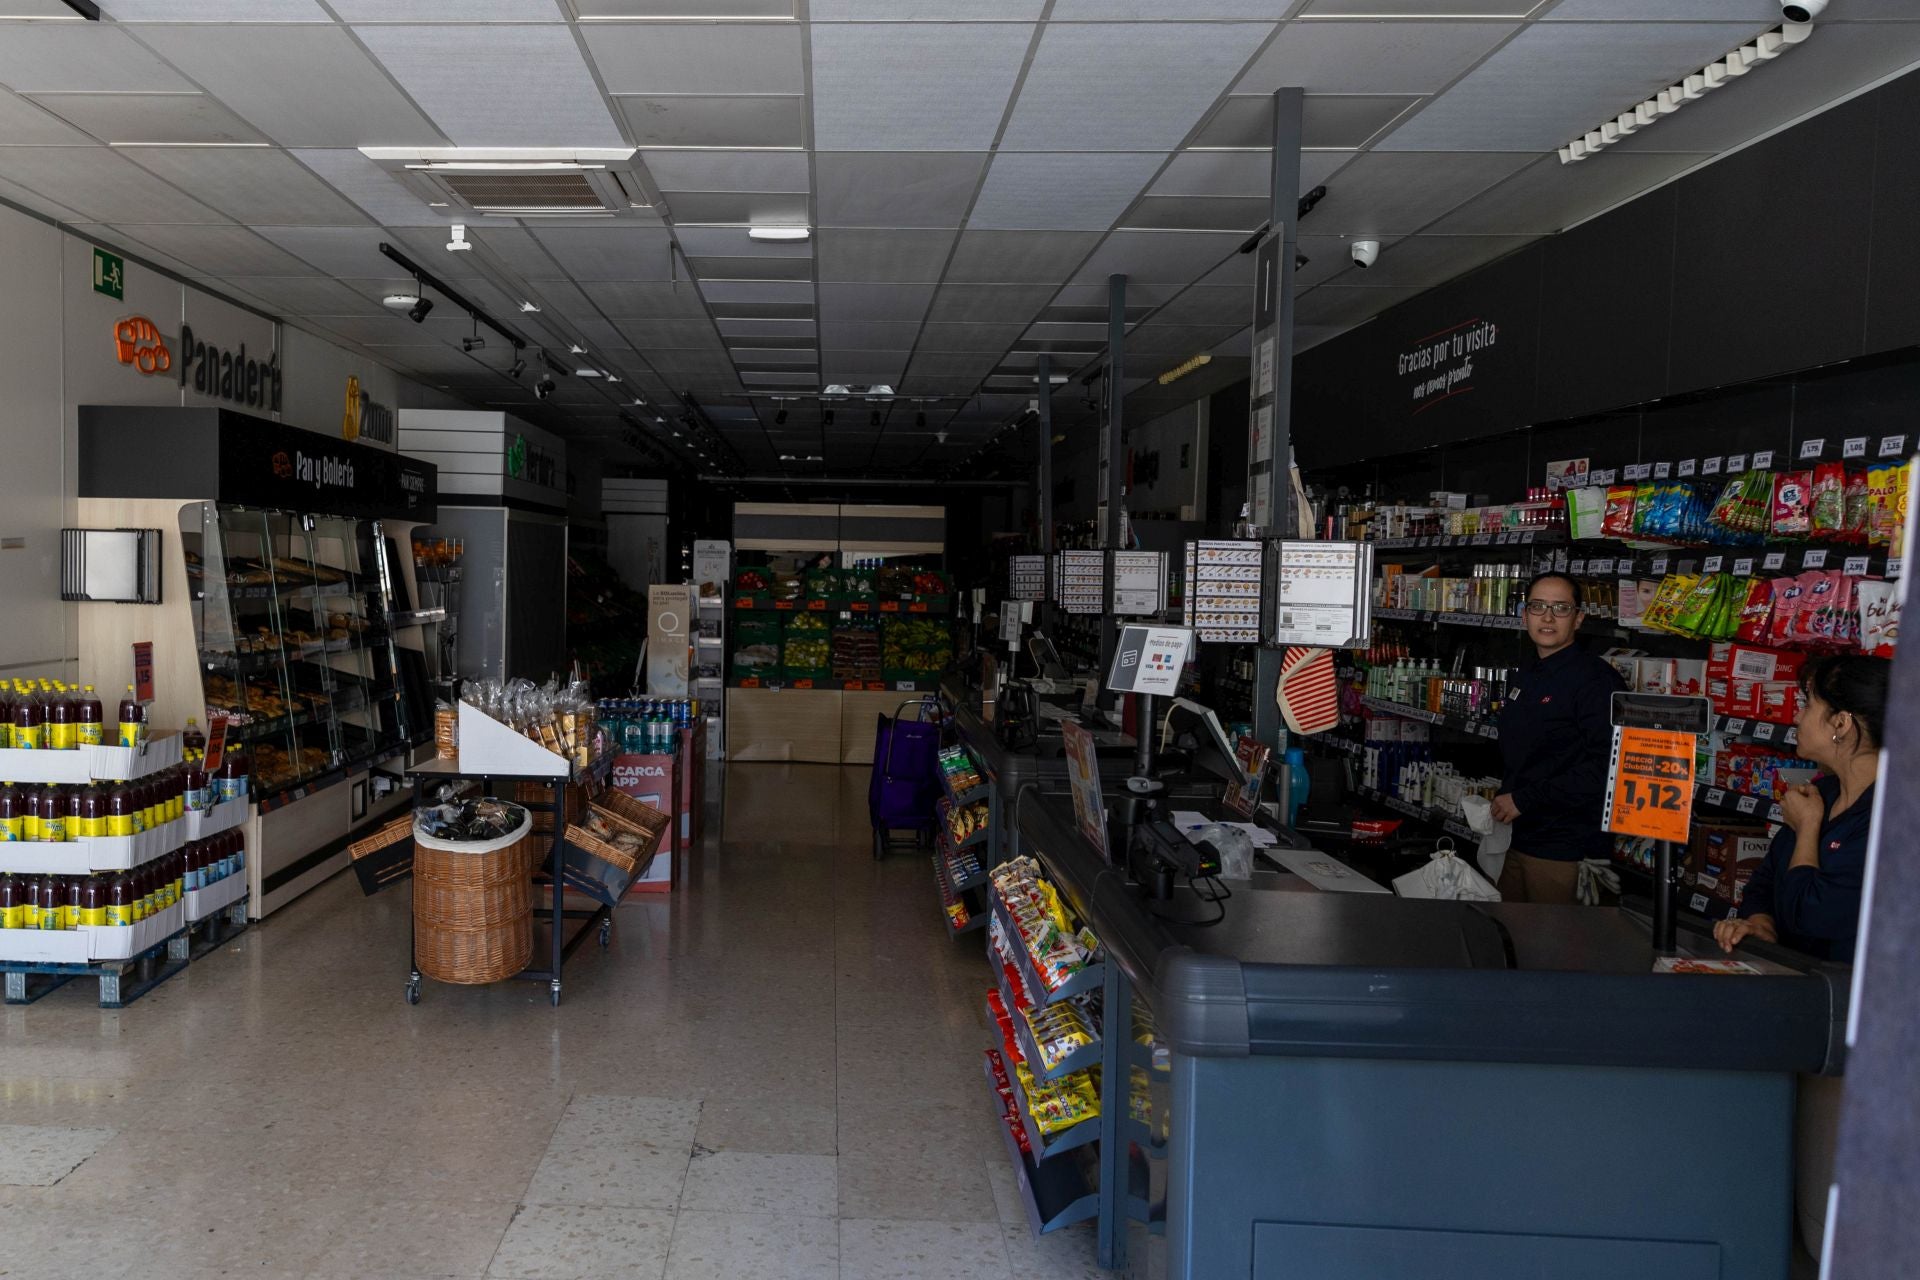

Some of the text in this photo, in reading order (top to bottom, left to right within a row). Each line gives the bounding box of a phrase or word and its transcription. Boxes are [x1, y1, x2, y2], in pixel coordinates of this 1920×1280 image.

[1398, 320, 1496, 376] Gracias por tu visita
[181, 324, 282, 412] Panadería
[296, 450, 356, 489] Pan y Bollería
[1625, 755, 1653, 764] PRECIO
[1624, 779, 1682, 811] 1,12
